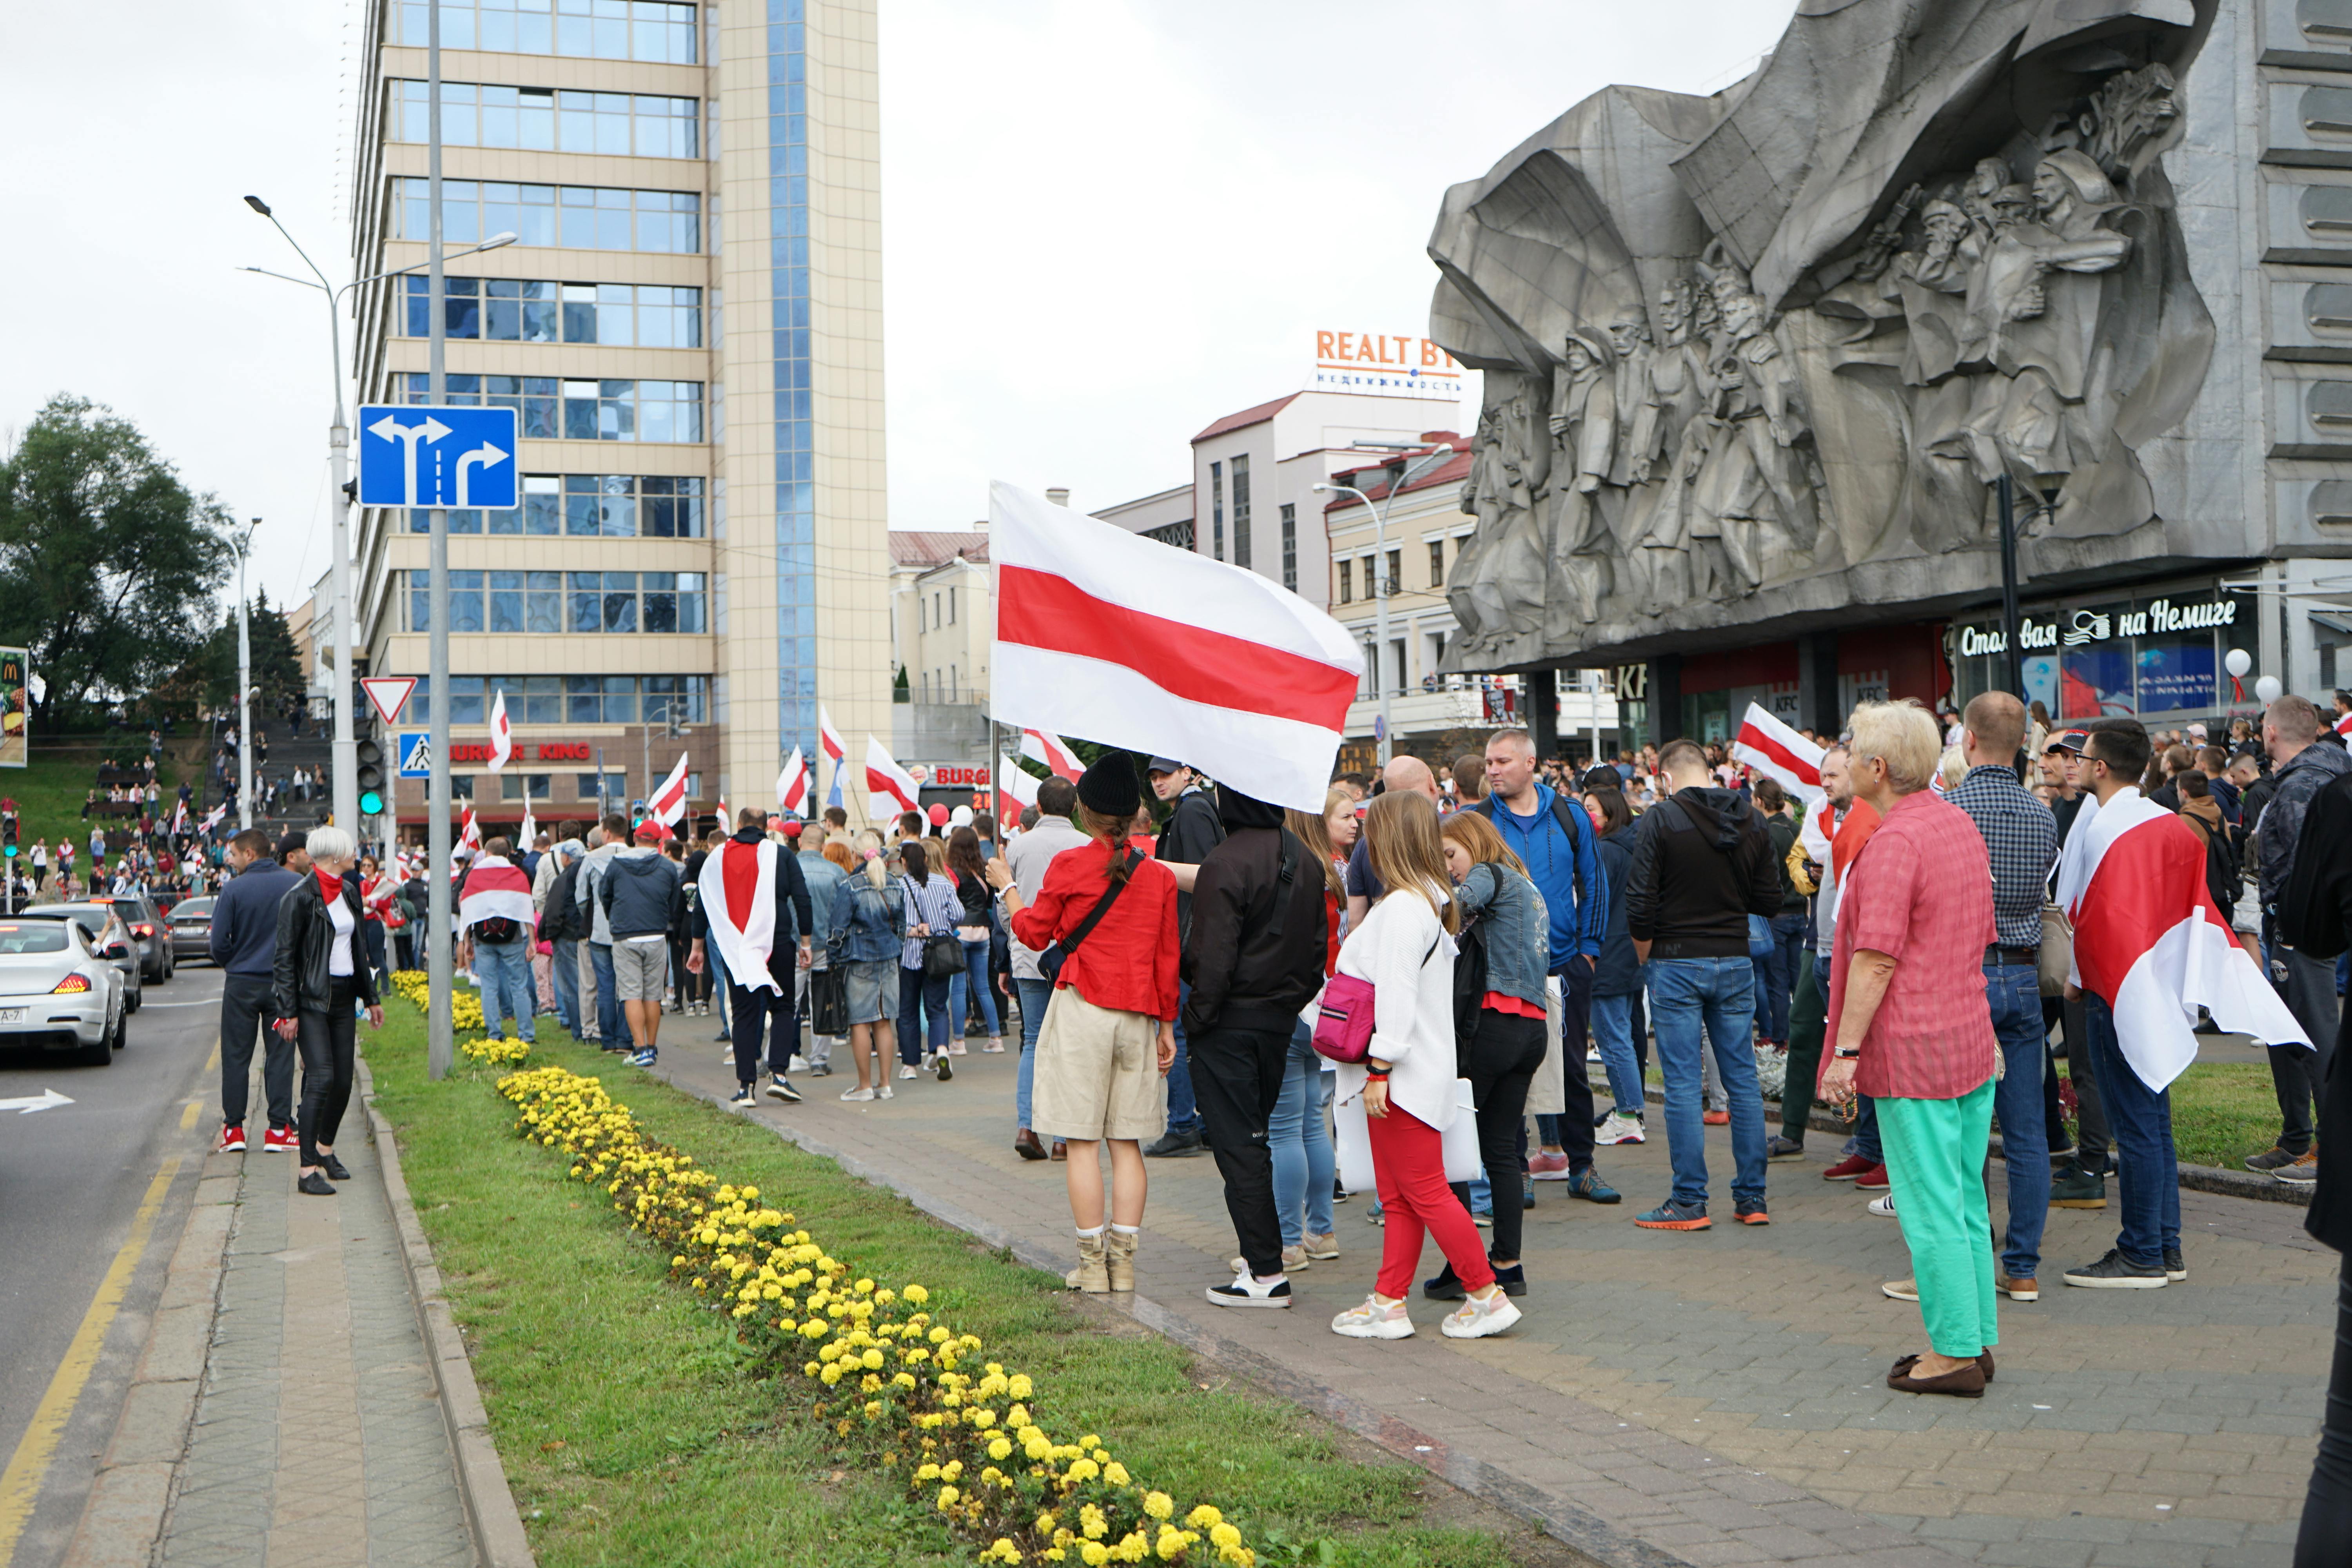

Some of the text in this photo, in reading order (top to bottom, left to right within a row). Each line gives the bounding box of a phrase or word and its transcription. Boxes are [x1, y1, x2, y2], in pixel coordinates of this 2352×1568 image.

[1318, 330, 1412, 364] REALT
[1318, 374, 1461, 391] НЕДВИЖИМОСТЬ
[1962, 599, 2236, 657] Столвая на Немиге
[1775, 695, 1798, 713] KFC
[539, 742, 590, 760] KING
[973, 793, 982, 809] 2
[1, 1010, 20, 1020] A-7
